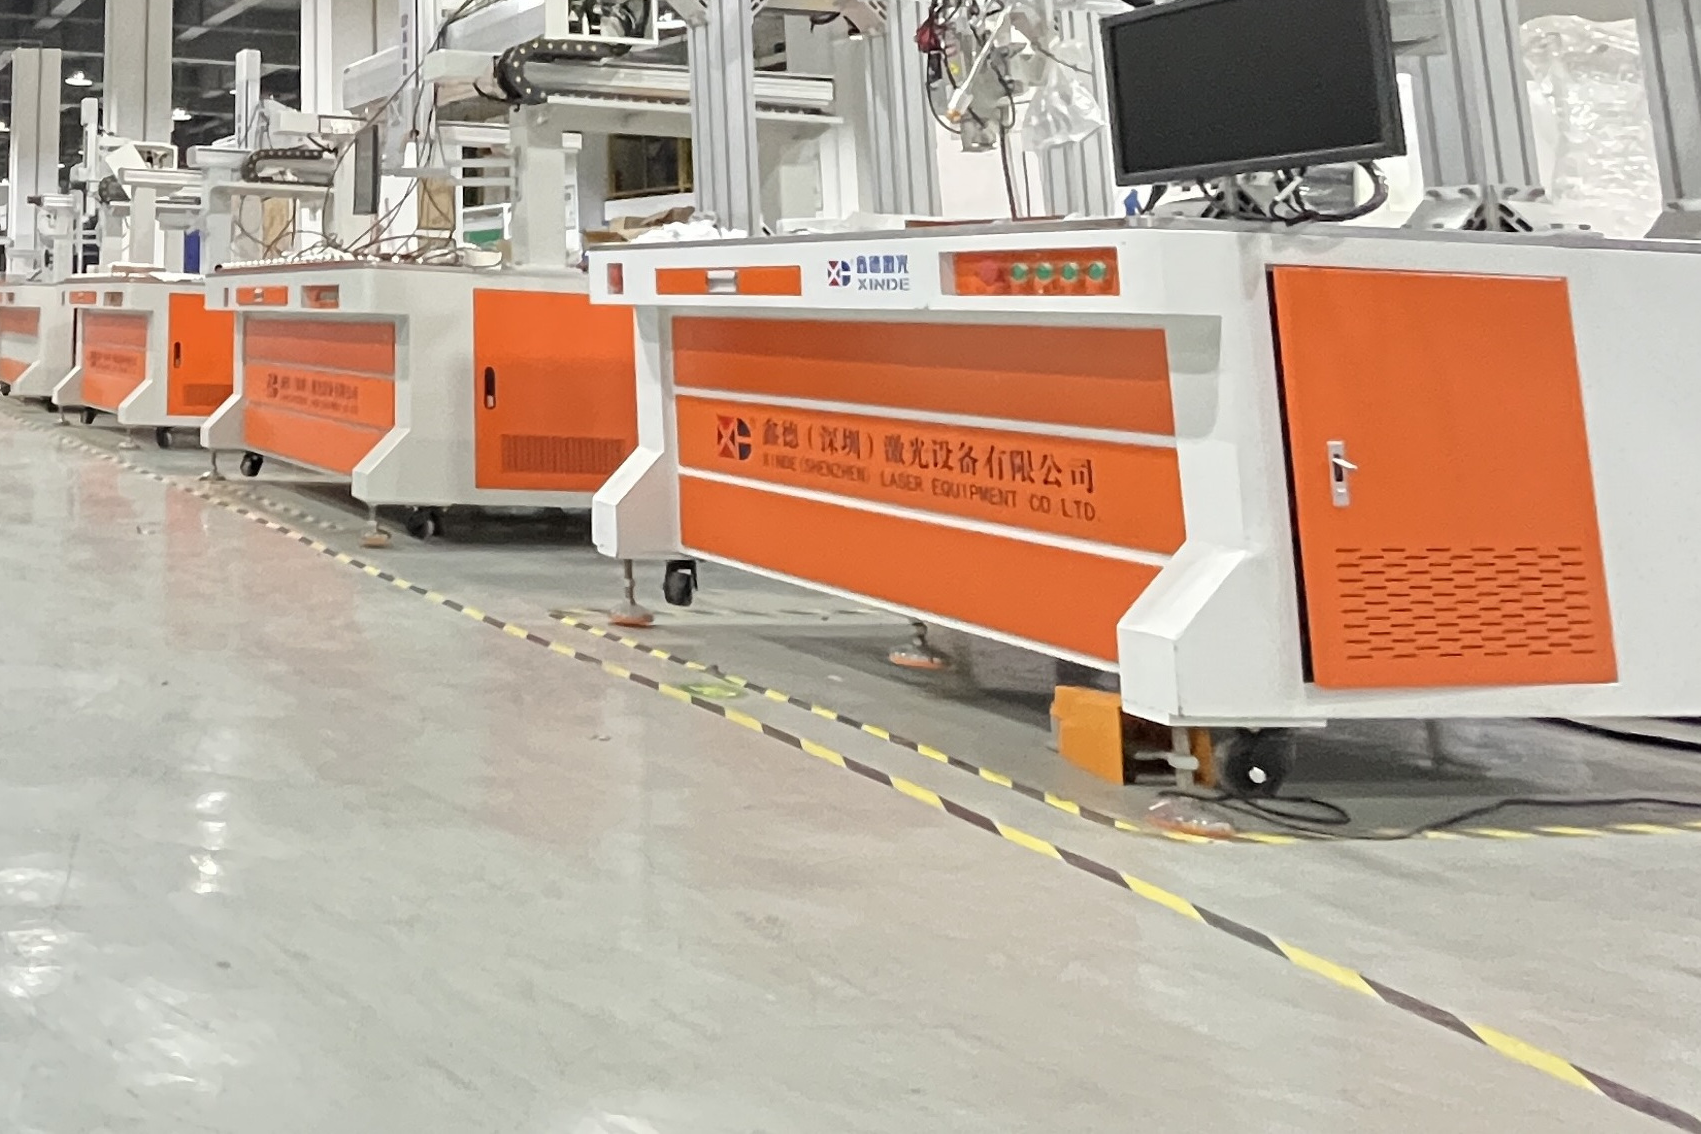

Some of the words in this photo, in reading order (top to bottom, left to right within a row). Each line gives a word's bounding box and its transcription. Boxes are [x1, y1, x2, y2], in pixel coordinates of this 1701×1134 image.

[857, 277, 910, 291] XINDE
[880, 470, 924, 492] LASER
[930, 477, 1017, 508] EQUIPMENT
